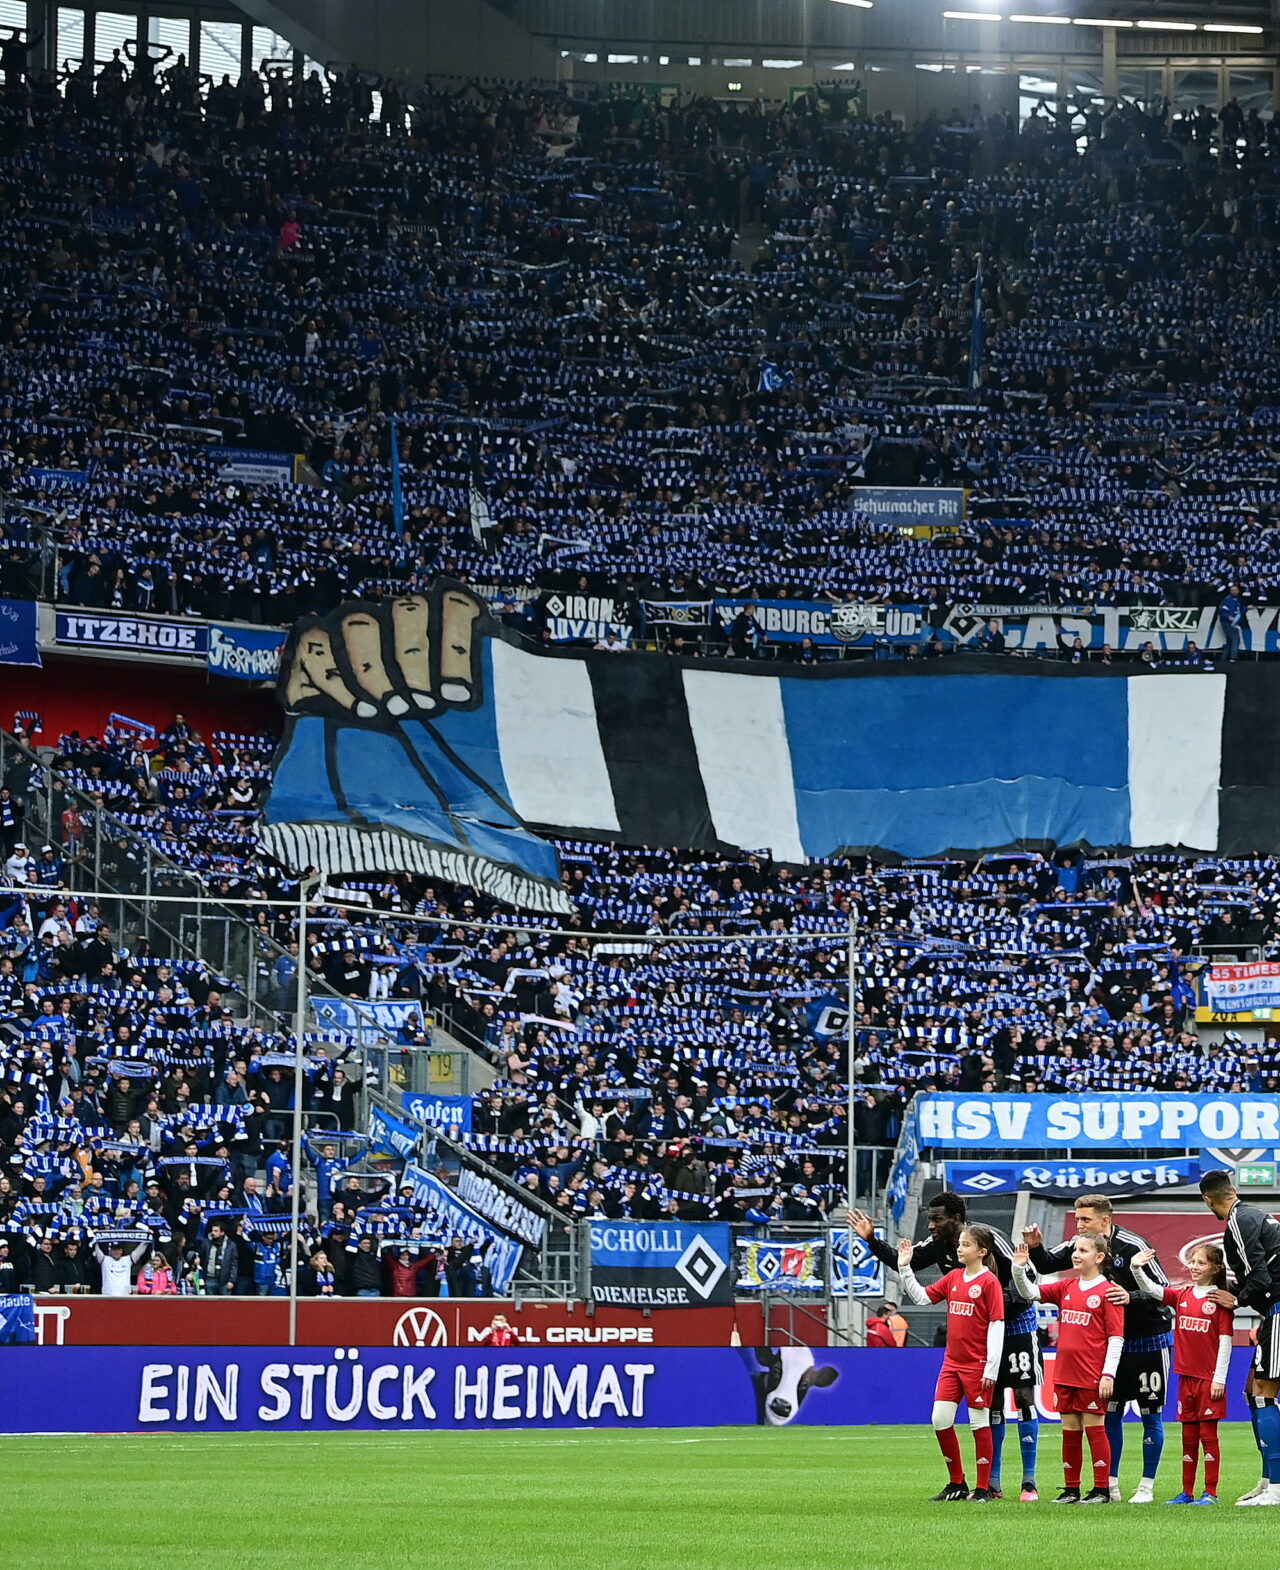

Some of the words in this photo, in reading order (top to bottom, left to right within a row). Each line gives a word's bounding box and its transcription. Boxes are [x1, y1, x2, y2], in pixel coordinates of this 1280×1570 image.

[853, 497, 935, 516] Schumacher
[938, 498, 959, 516] Alt
[565, 595, 614, 623] IRON
[66, 617, 196, 650] ITZEHOE
[1211, 968, 1230, 980] 55
[1234, 963, 1279, 977] TIMES
[409, 1097, 464, 1124] Hafen
[919, 1100, 1032, 1140] HSV
[1021, 1163, 1180, 1190] Lübeck
[589, 1227, 683, 1252] SCHOLLI
[591, 1284, 690, 1305] DIEMELSEE
[949, 1301, 975, 1317] TUFFI
[1060, 1309, 1092, 1326] TUFFI
[468, 1326, 541, 1343] MLL
[546, 1326, 654, 1343] GRUPPE
[1178, 1315, 1211, 1333] TUFFI
[1008, 1351, 1031, 1373] 18
[138, 1362, 239, 1423] EIN
[258, 1346, 437, 1422] STÜCK
[454, 1362, 655, 1421] HEIMAT
[1138, 1371, 1162, 1393] 10
